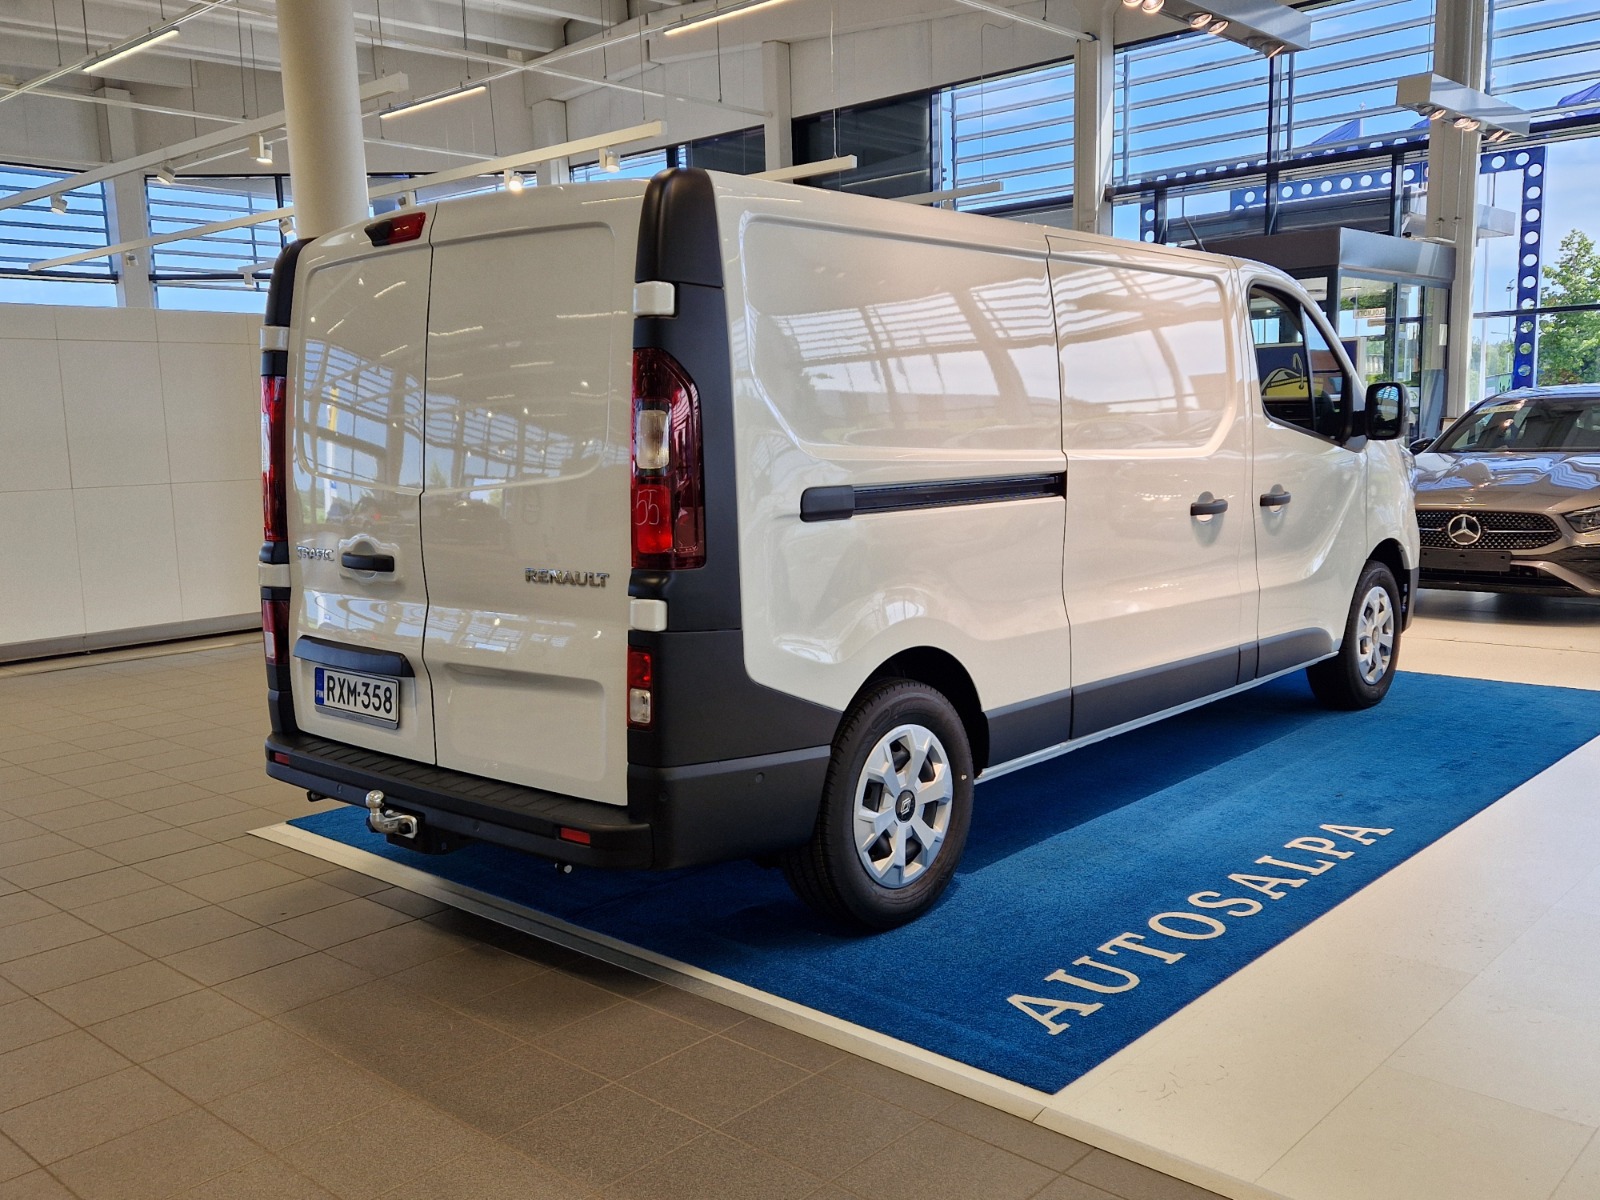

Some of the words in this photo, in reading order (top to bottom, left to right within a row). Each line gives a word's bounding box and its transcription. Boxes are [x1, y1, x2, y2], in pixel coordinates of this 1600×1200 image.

[296, 545, 334, 561] TRAFIC
[525, 567, 610, 588] RENAULT
[326, 675, 393, 714] RXM-358
[1006, 823, 1394, 1036] AUTOSALPA
